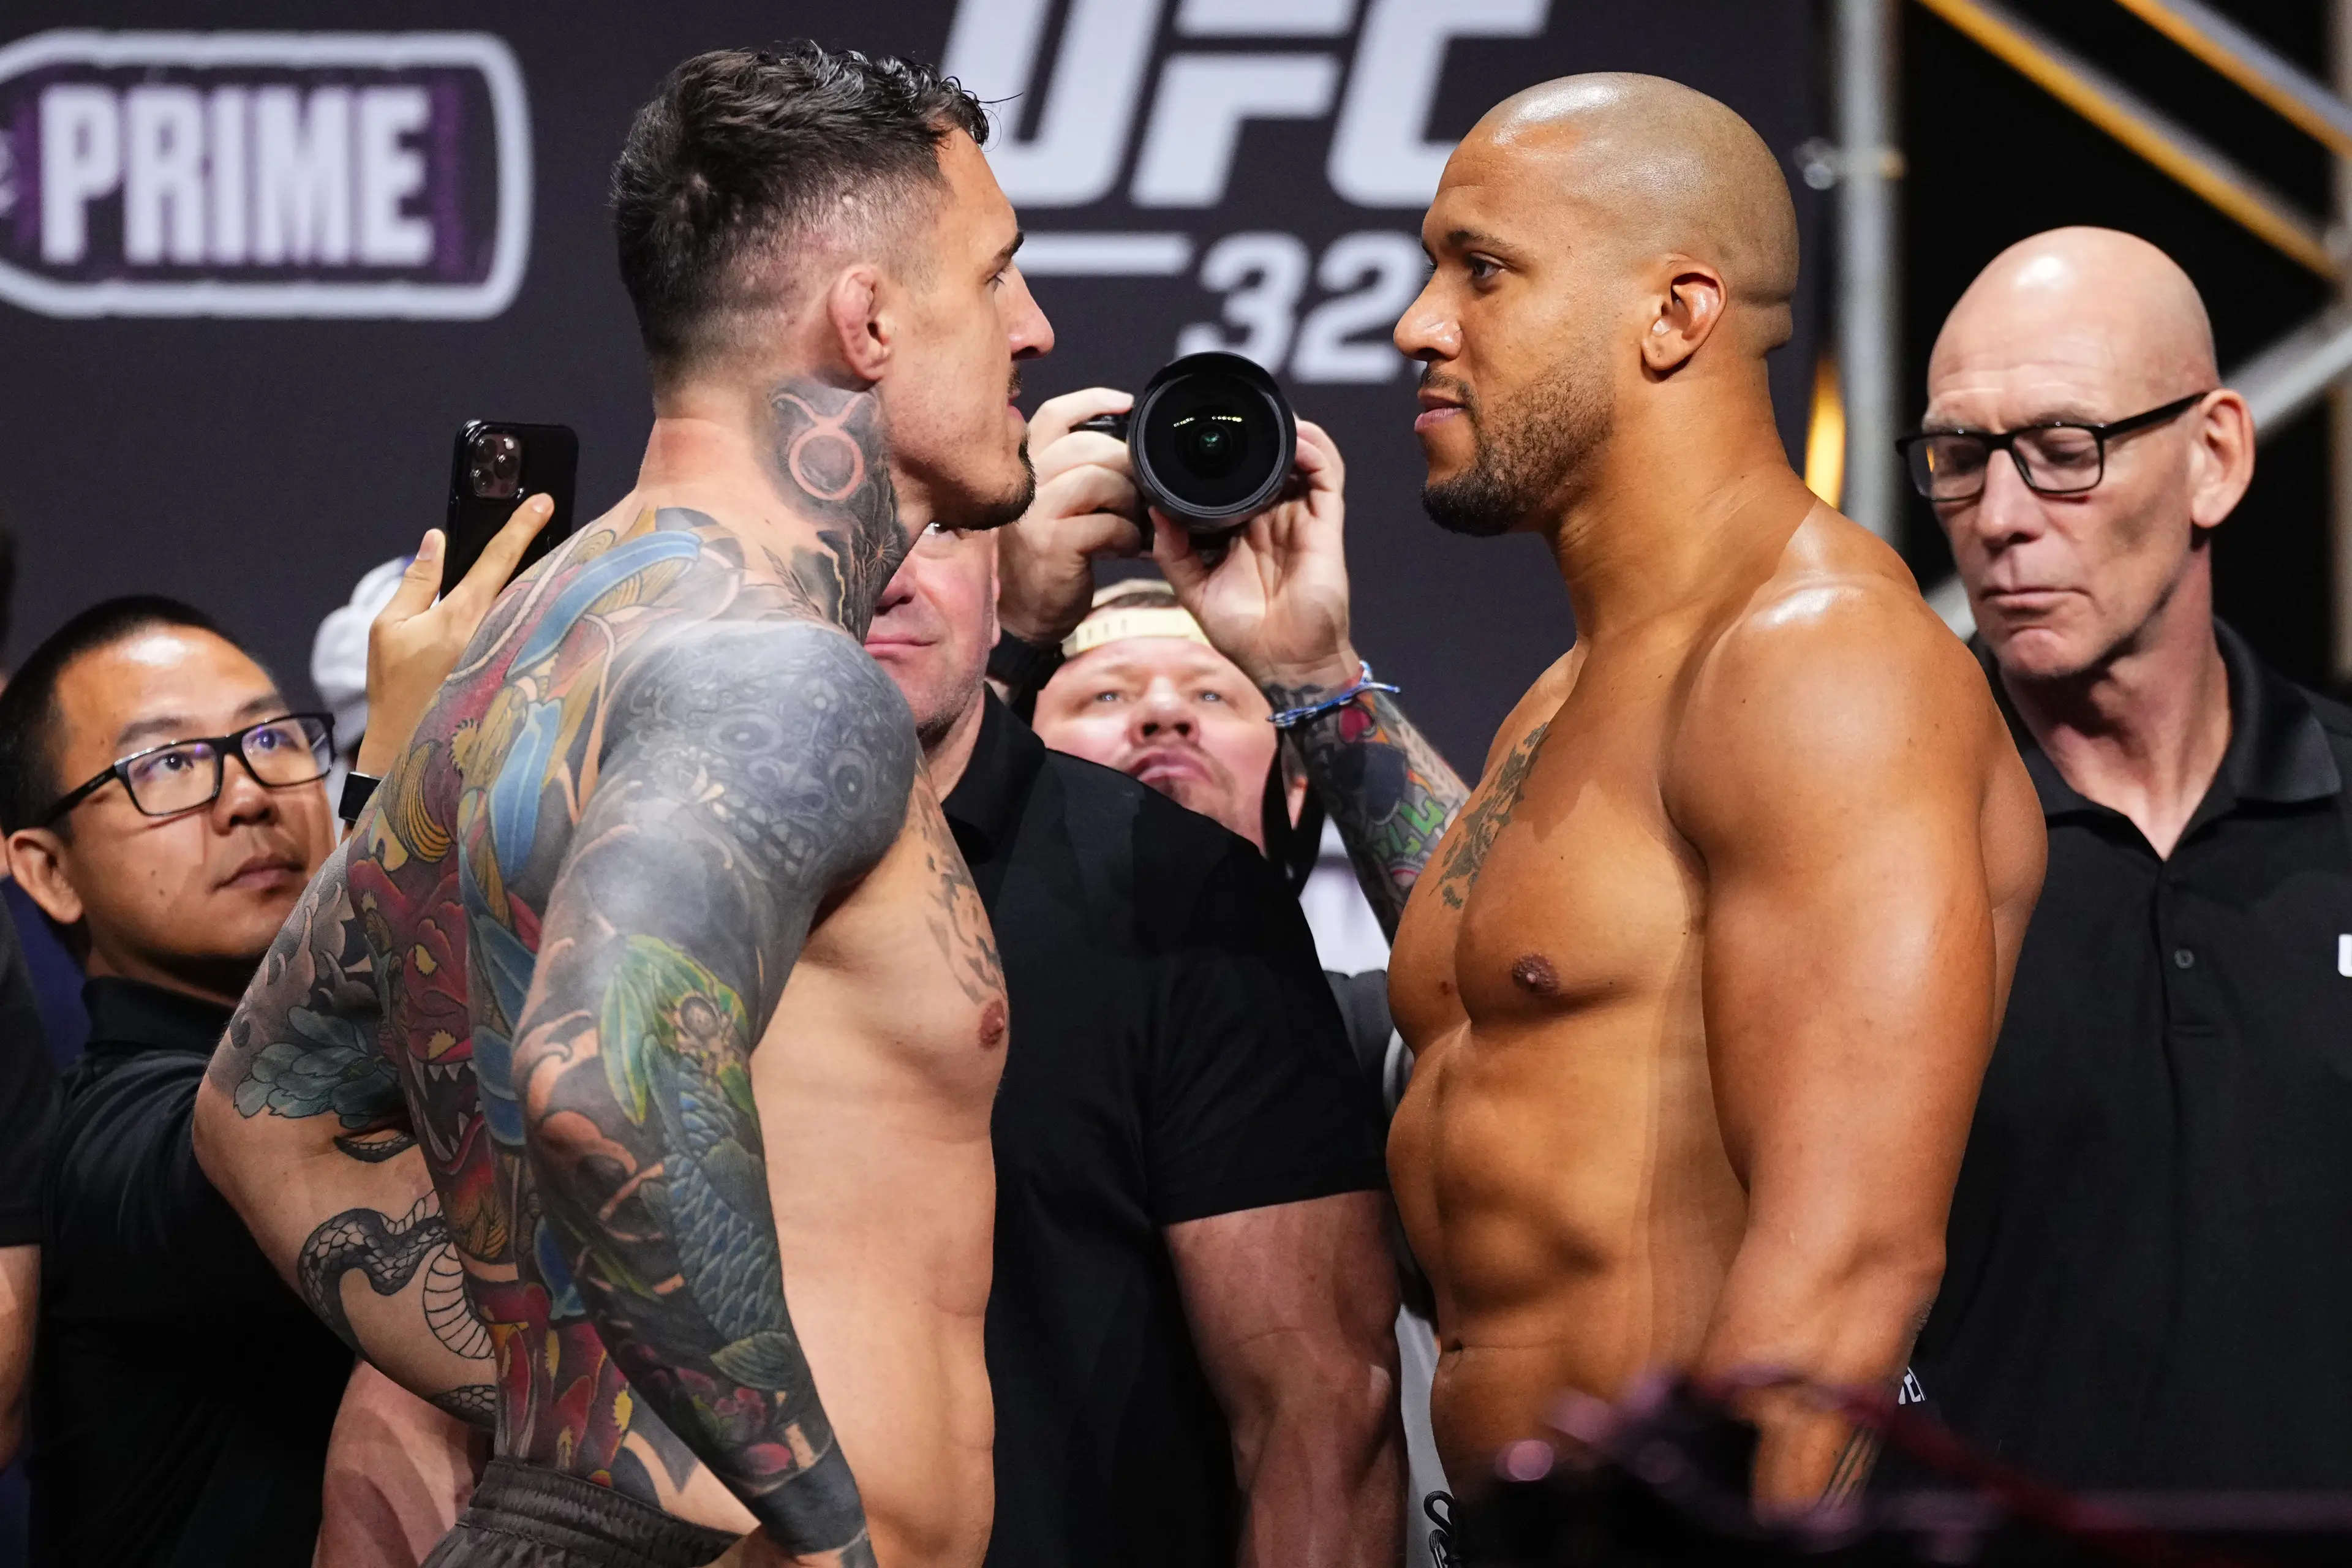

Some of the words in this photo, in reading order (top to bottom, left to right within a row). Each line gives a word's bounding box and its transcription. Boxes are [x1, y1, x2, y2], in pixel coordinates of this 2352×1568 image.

[40, 85, 432, 266] PRIME
[941, 0, 1547, 209] UFC
[1176, 230, 1427, 383] 32
